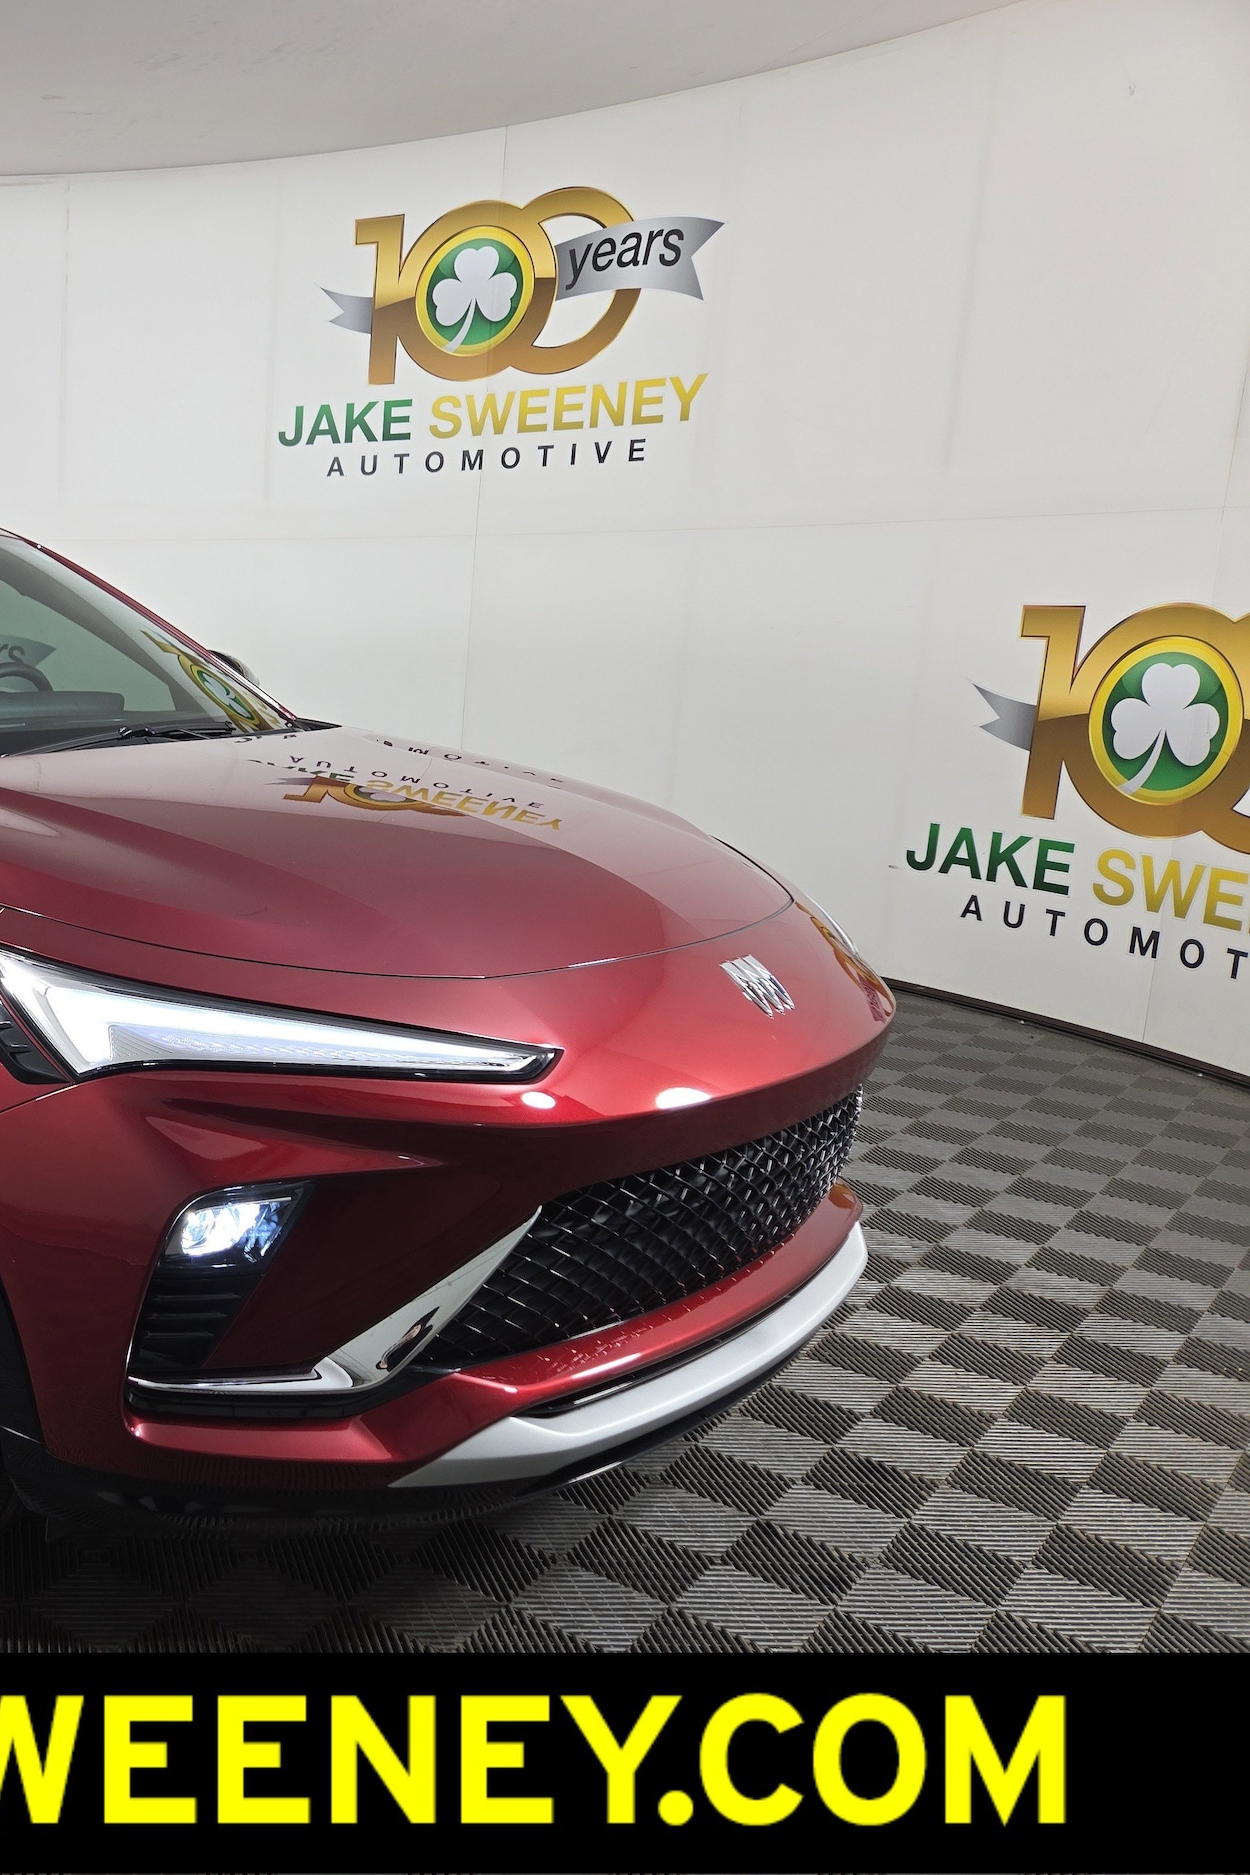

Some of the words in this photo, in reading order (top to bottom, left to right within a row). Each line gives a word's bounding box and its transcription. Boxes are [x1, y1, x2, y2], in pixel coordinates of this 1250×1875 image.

[354, 187, 642, 385] 100
[565, 228, 685, 291] years
[278, 398, 413, 446] JAKE
[429, 373, 708, 439] SWEENEY
[326, 438, 646, 477] AUTOMOTIVE
[1019, 602, 1250, 854] 10
[906, 822, 1076, 897] JAKE
[1092, 848, 1250, 933] SWE
[960, 894, 1249, 980] AUTOMOT
